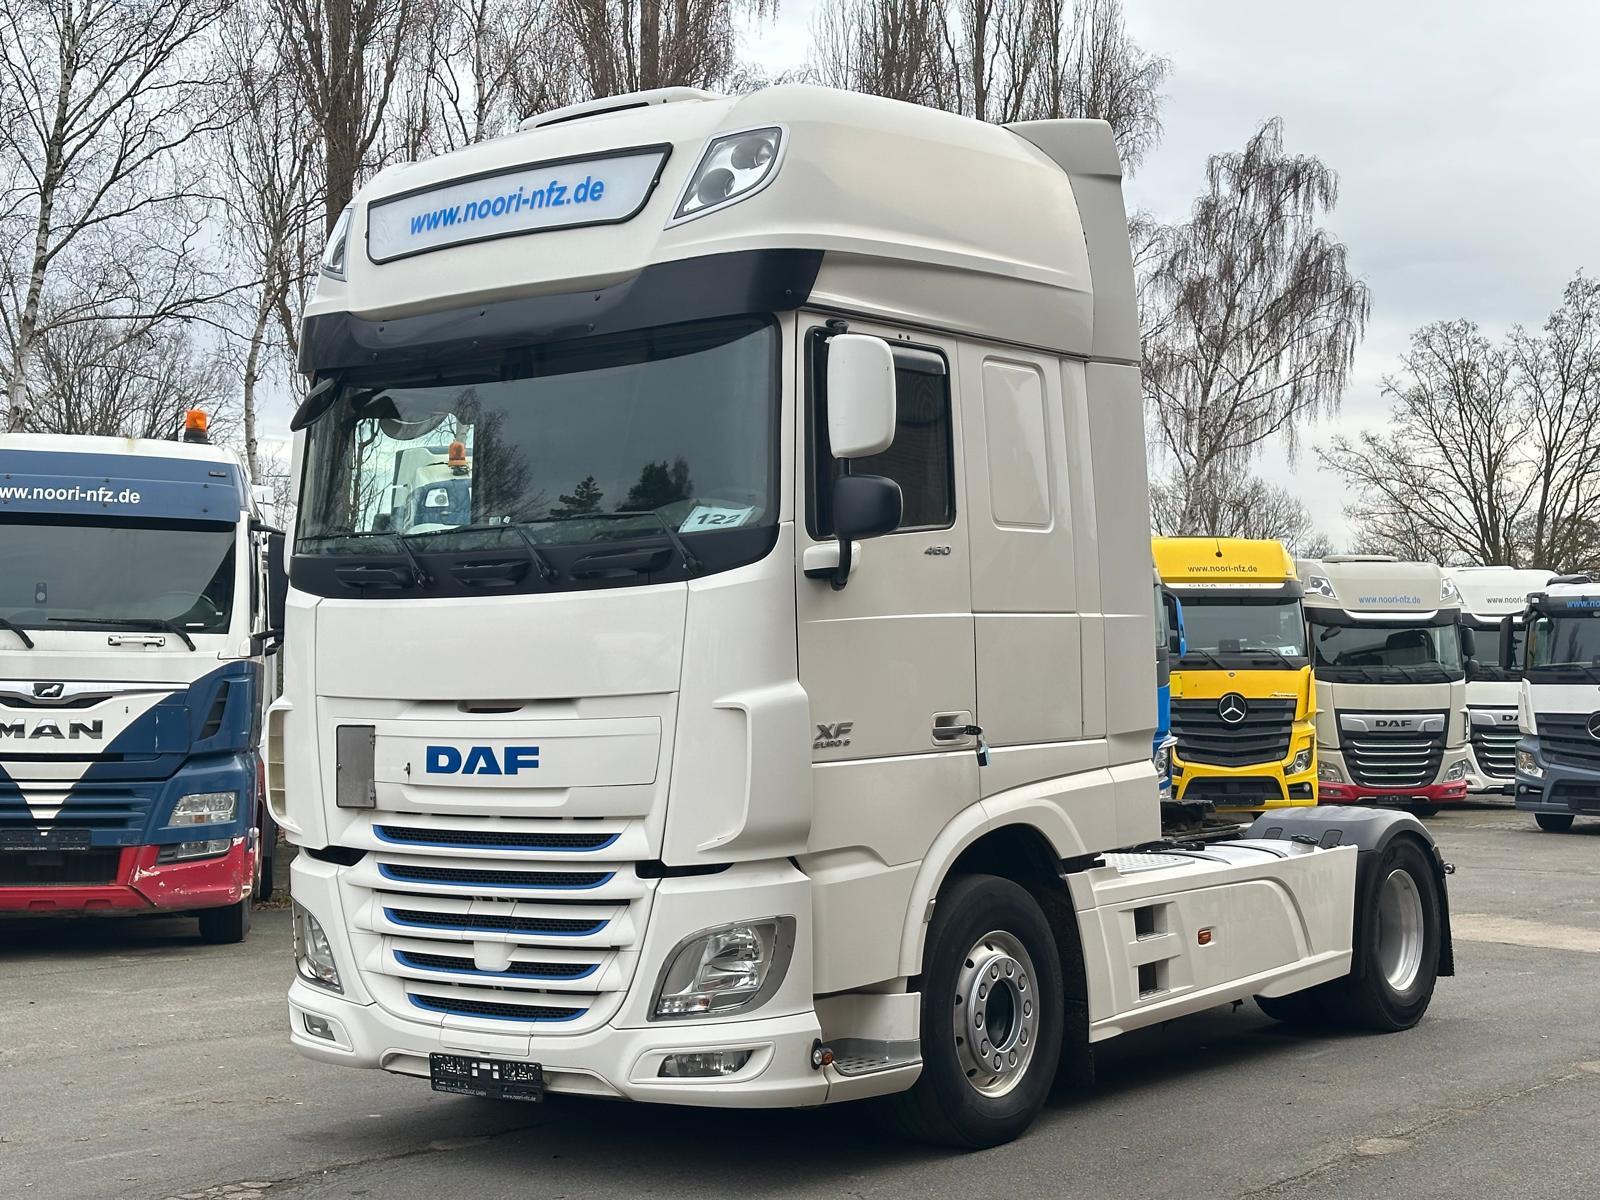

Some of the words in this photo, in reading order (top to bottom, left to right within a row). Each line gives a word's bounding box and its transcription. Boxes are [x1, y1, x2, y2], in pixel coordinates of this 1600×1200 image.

[409, 175, 605, 235] www.noori-nfz.de
[924, 545, 951, 556] 460
[1187, 564, 1258, 573] www.noori-nfz.de
[1358, 595, 1421, 604] www.noori-nfz.de
[0, 718, 103, 739] MAN
[1375, 719, 1412, 727] DAF
[814, 722, 854, 740] XF
[813, 740, 842, 749] EURO
[843, 740, 851, 748] 6
[426, 745, 539, 775] DAF
